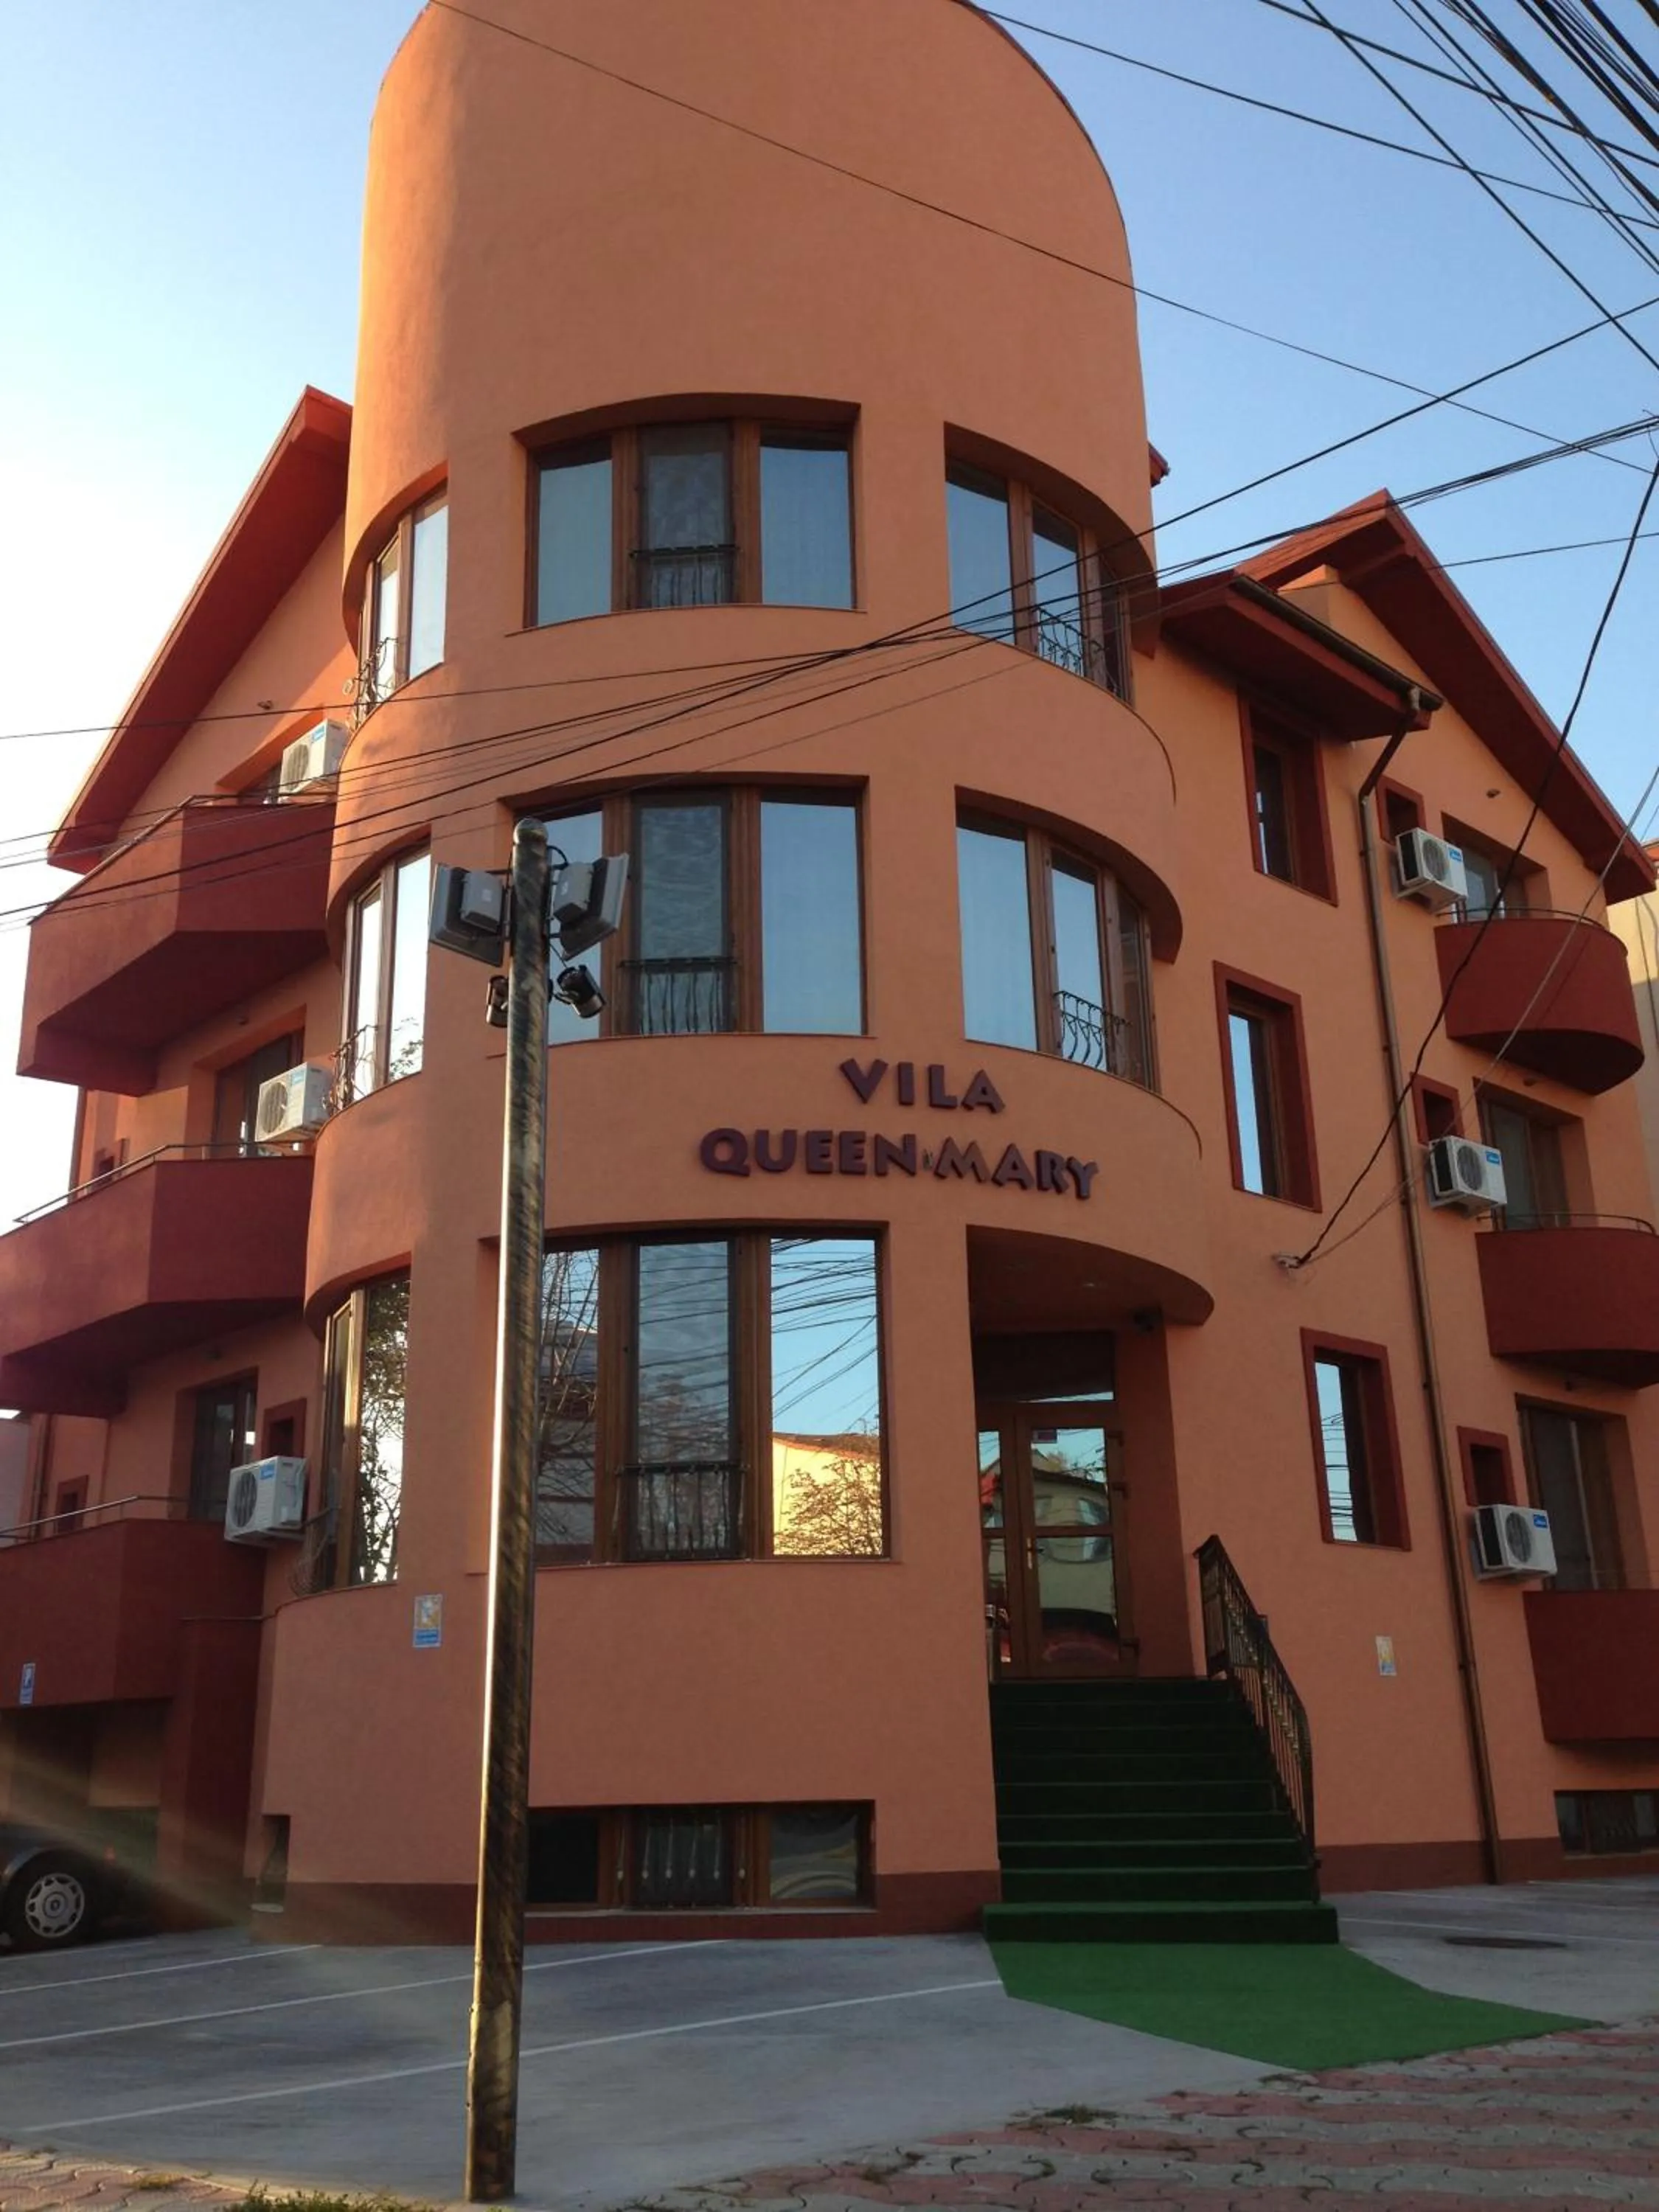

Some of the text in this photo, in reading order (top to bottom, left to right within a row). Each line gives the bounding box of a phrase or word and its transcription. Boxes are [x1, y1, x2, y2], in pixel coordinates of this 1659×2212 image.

[839, 1058, 1005, 1113] VILA
[699, 1128, 1099, 1200] QUEEN MARY
